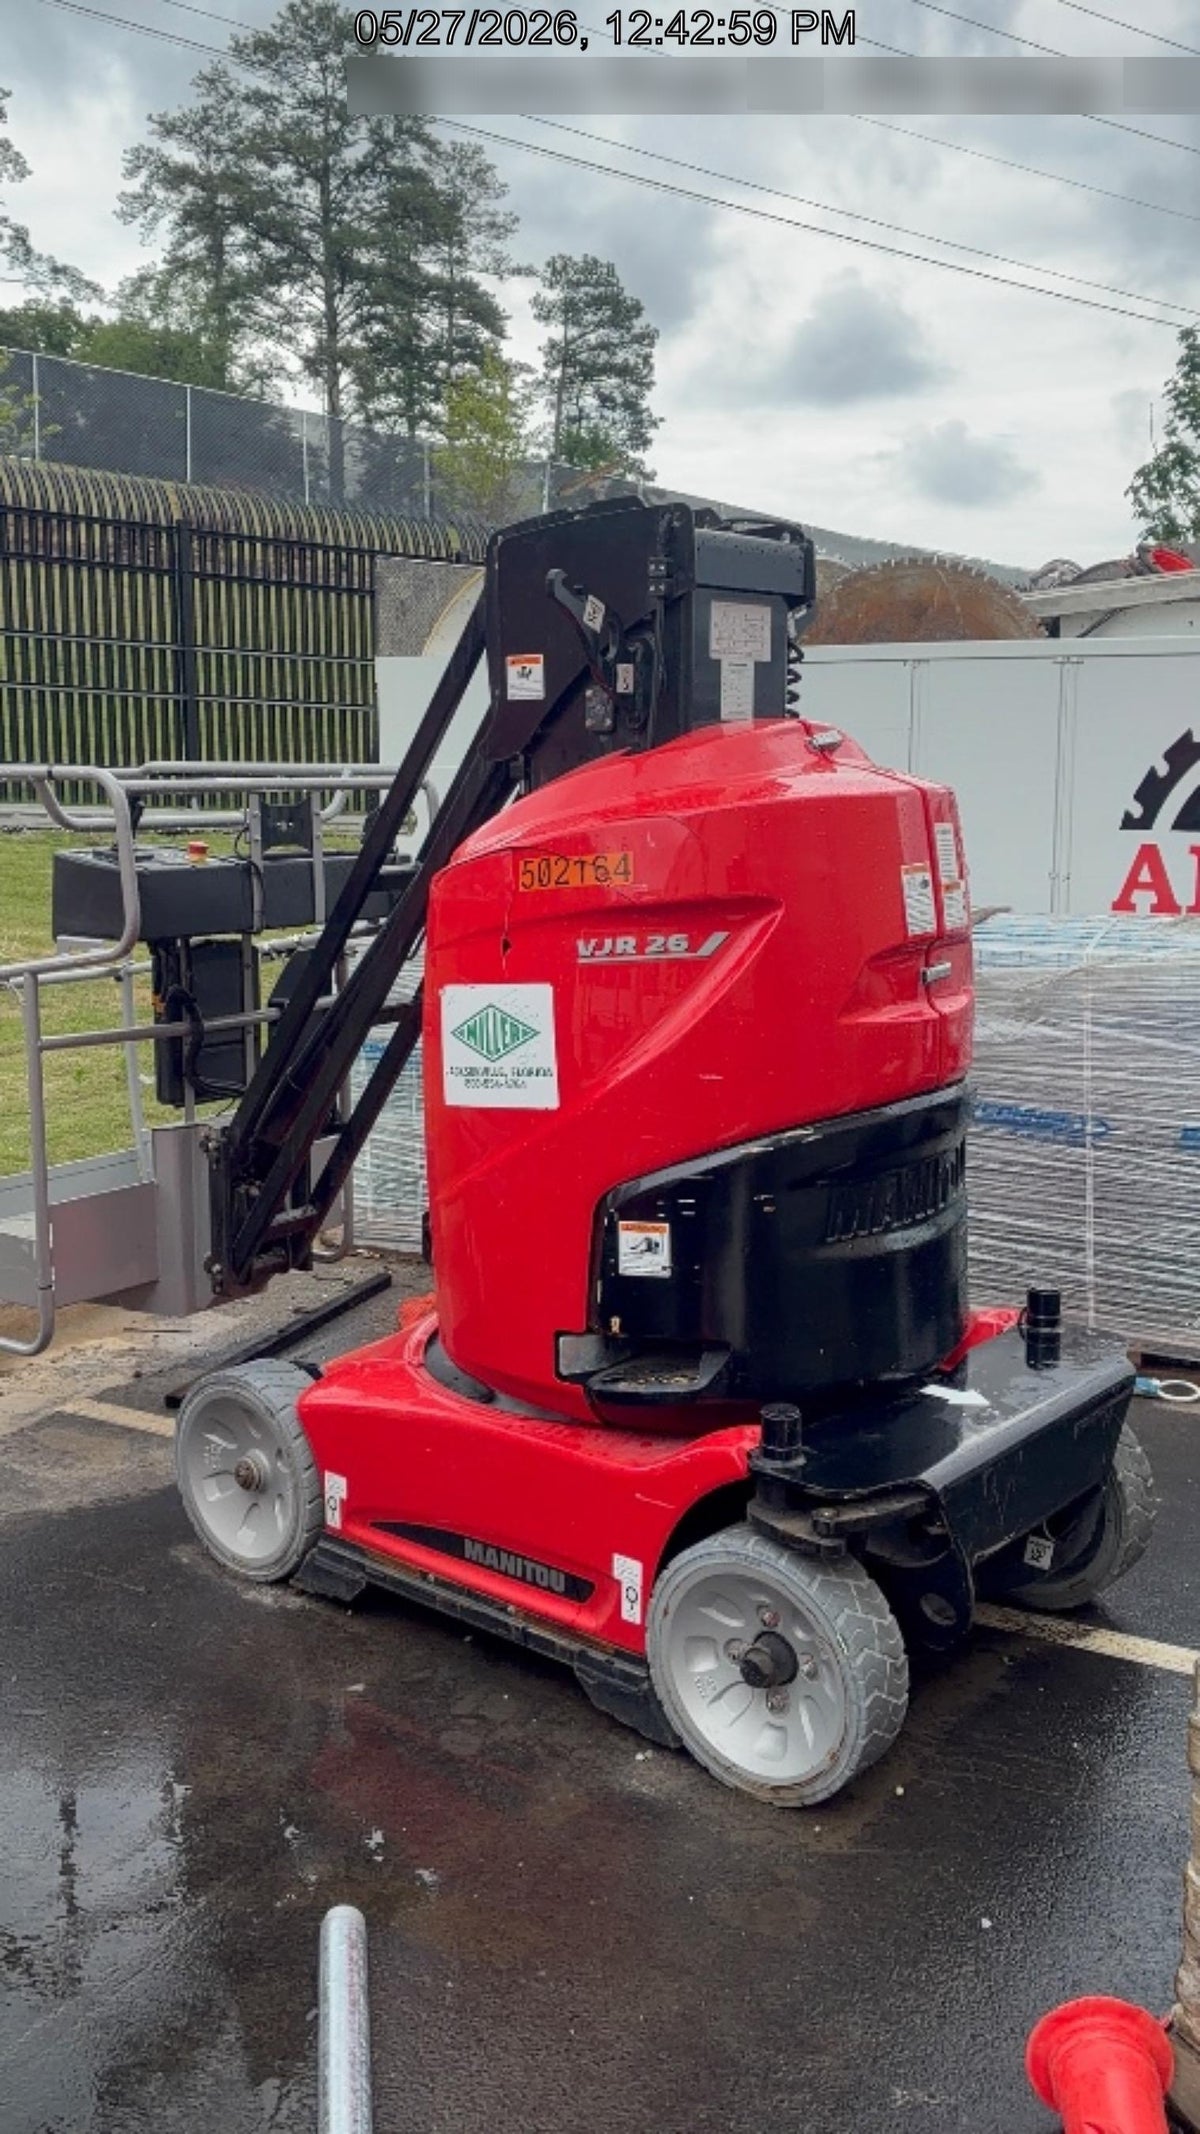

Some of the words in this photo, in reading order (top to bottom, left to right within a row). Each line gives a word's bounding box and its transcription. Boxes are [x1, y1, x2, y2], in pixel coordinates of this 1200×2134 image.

[521, 853, 632, 889] 502164
[1111, 843, 1200, 914] A
[576, 936, 636, 958] VJR
[645, 933, 688, 954] 26
[464, 1538, 566, 1592] MANITOU
